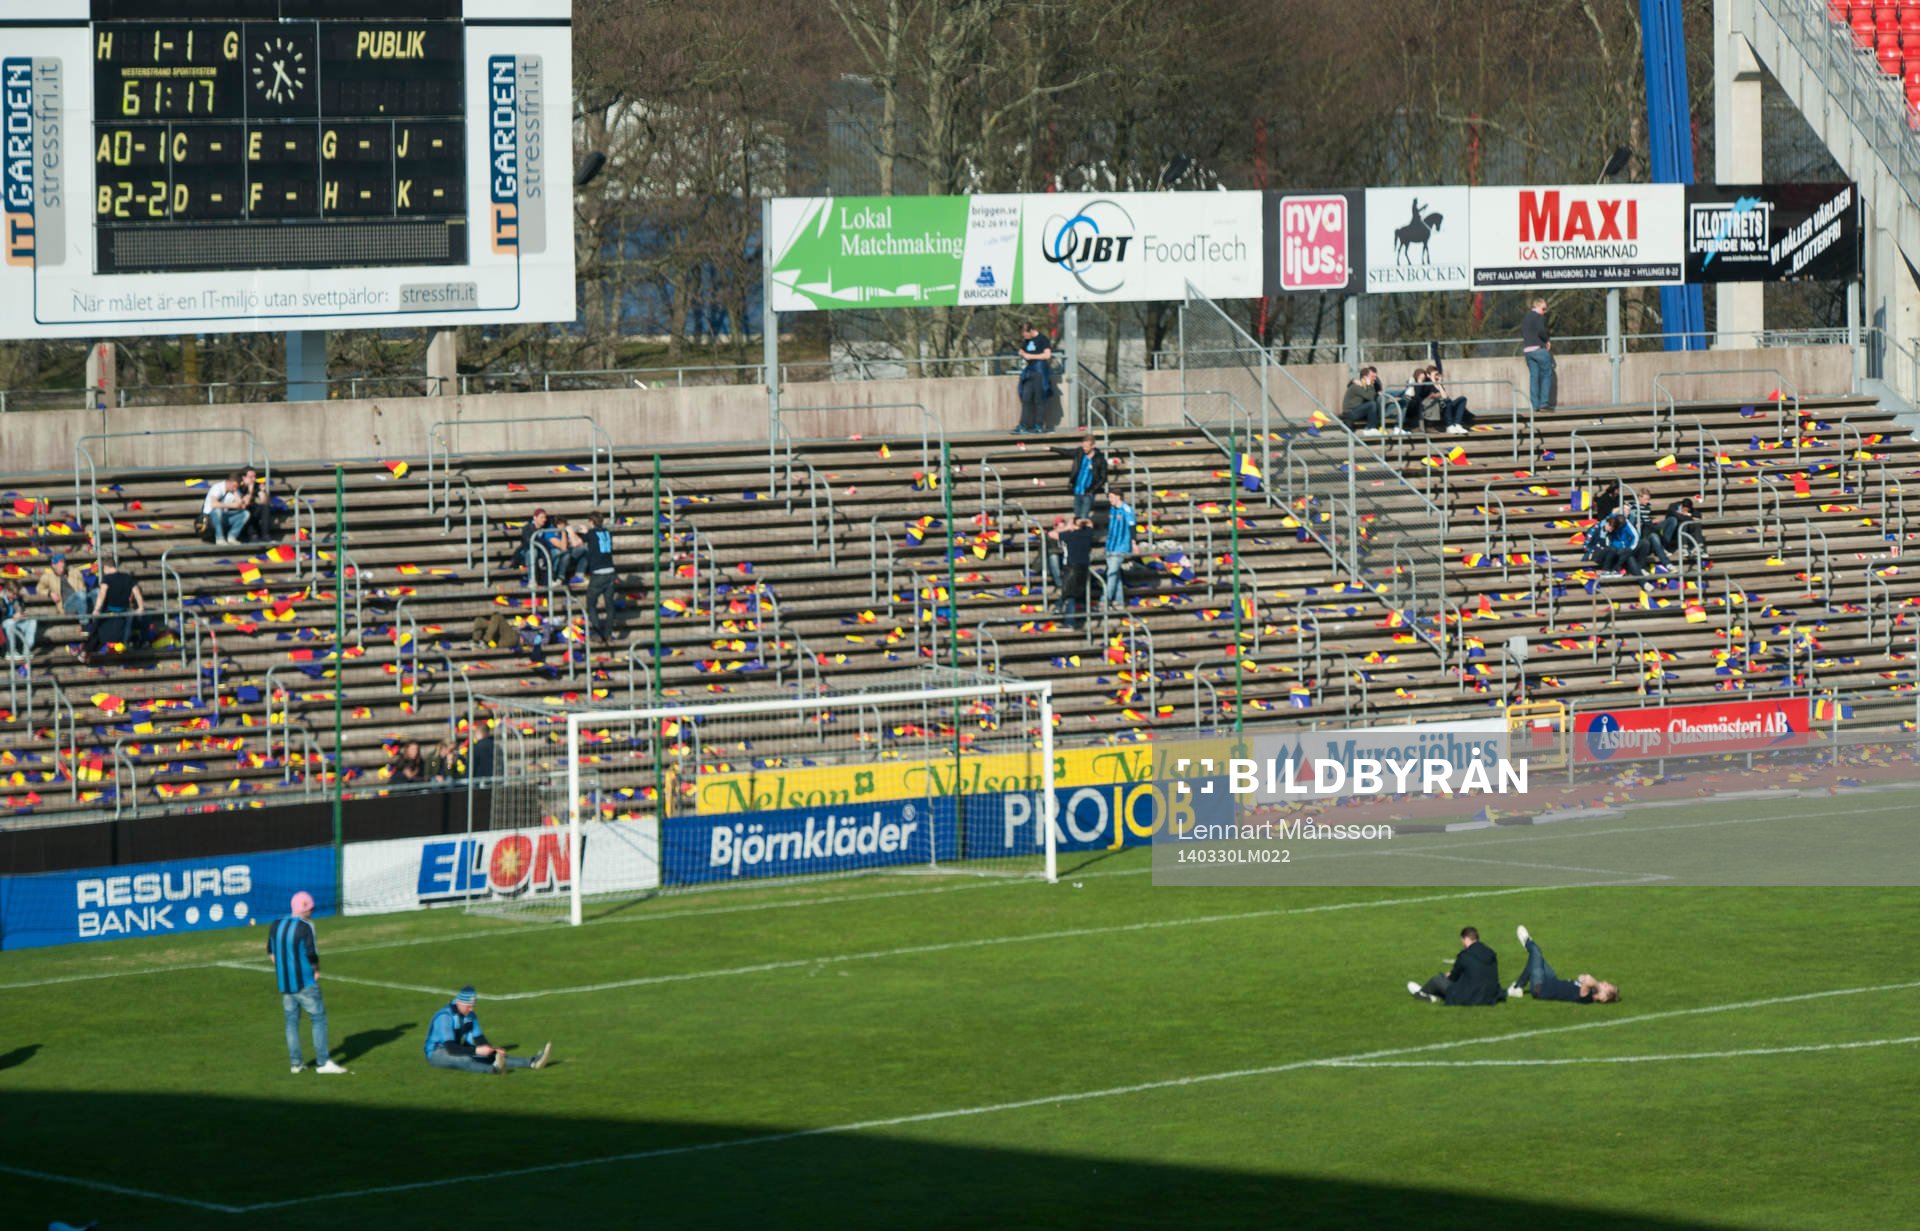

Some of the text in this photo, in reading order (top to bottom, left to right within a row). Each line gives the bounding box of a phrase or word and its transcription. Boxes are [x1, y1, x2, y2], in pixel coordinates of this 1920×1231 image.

[97, 32, 113, 60] H
[223, 31, 239, 60] G
[356, 31, 427, 59] PUBLIK
[122, 80, 215, 115] 61:17
[35, 64, 60, 209] stressfri.it
[397, 129, 409, 159] J
[518, 60, 541, 199] stressfri.it
[172, 132, 188, 162] C
[248, 131, 263, 160] E
[322, 130, 338, 160] G
[493, 61, 519, 247] IT GARDEN
[7, 65, 36, 258] IT GARDEN
[173, 183, 189, 213] D
[249, 182, 263, 211] F
[323, 181, 339, 209] H
[397, 179, 412, 208] K
[840, 206, 892, 230] Lokal
[971, 206, 1018, 217] briggen.se
[1286, 203, 1342, 241] nya
[1696, 210, 1763, 239] KLOTTRETS
[1770, 186, 1851, 266] VI HÅLLER VÄRLDEN
[840, 232, 964, 259] Matchmaking
[1076, 233, 1247, 263] JBT FoodTech
[1518, 244, 1639, 261] ICA STORMARKNAD
[1696, 239, 1739, 253] FIENDE
[1792, 217, 1842, 274] KLOTTERFRI
[1368, 264, 1467, 284] STENBOCKEN
[1498, 270, 1514, 280] ALLA
[1514, 270, 1537, 280] DAGAR
[73, 294, 104, 312] När
[109, 292, 152, 312] målet
[202, 289, 260, 313] IT-miljö
[263, 291, 297, 308] utan
[302, 286, 389, 310] svettpärlor:
[402, 282, 476, 303] stressfri.it
[963, 288, 1008, 299] BRIGGEN
[1598, 711, 1789, 754] Åstorps Glasmästeri AB
[1326, 733, 1499, 789] Myresjöhus
[702, 776, 850, 812] Nelson
[1004, 782, 1197, 850] PROJOB
[709, 811, 917, 876] Björnkläder
[417, 832, 582, 895] ELON
[77, 864, 252, 910] RESURS
[78, 903, 175, 938] BANK
